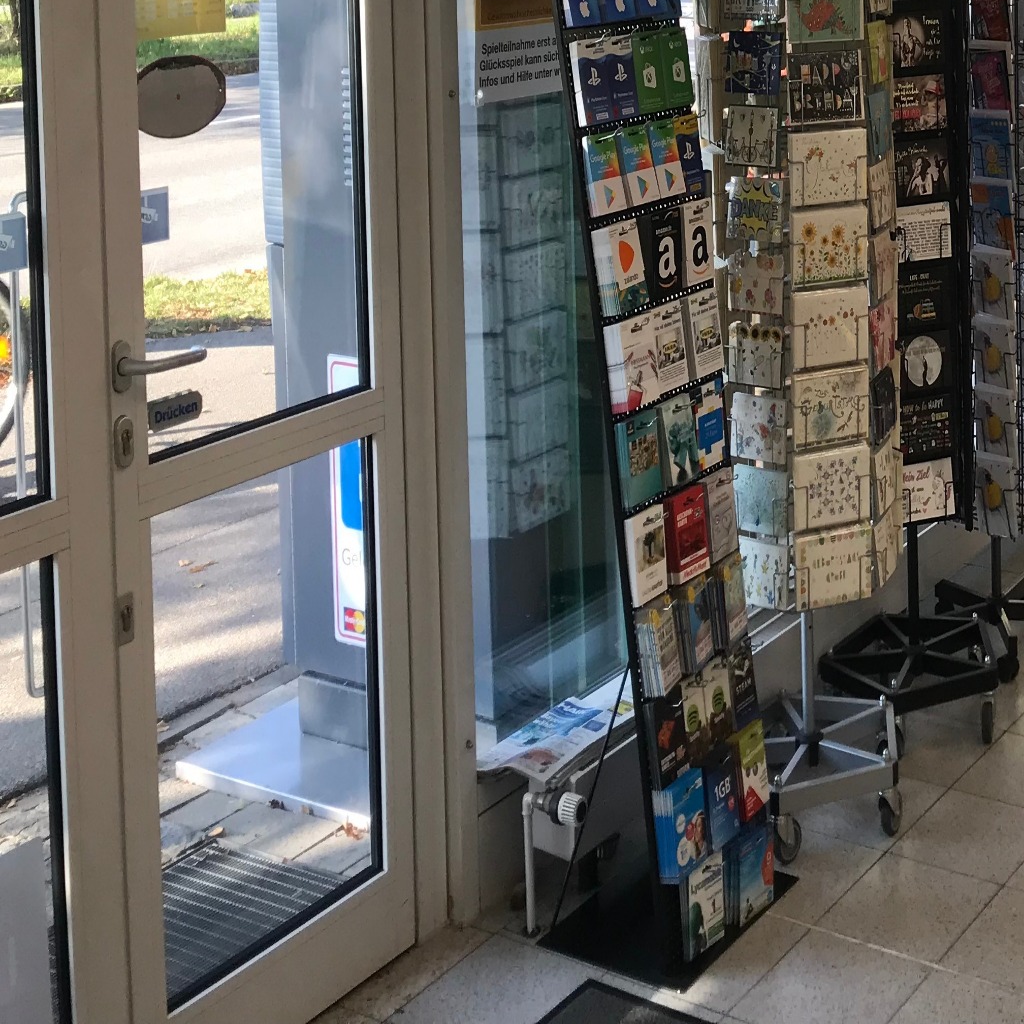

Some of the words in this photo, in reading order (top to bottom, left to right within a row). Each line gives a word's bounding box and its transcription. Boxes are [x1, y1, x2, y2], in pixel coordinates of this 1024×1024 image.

[480, 37, 536, 56] Spielteilnahme
[536, 36, 551, 49] erst
[479, 55, 524, 73] Glücksspiel
[524, 53, 542, 67] kann
[478, 73, 500, 88] Infos
[500, 72, 516, 86] und
[516, 70, 534, 83] Hilfe
[534, 69, 554, 81] unter
[589, 154, 606, 164] Google
[730, 196, 778, 222] DANKE
[692, 225, 709, 267] a
[658, 236, 677, 279] a
[154, 400, 199, 424] Drücken
[928, 398, 944, 409] HAPPY
[916, 466, 931, 482] Ziel
[735, 677, 752, 695] STEAM
[714, 776, 731, 802] 1GB
